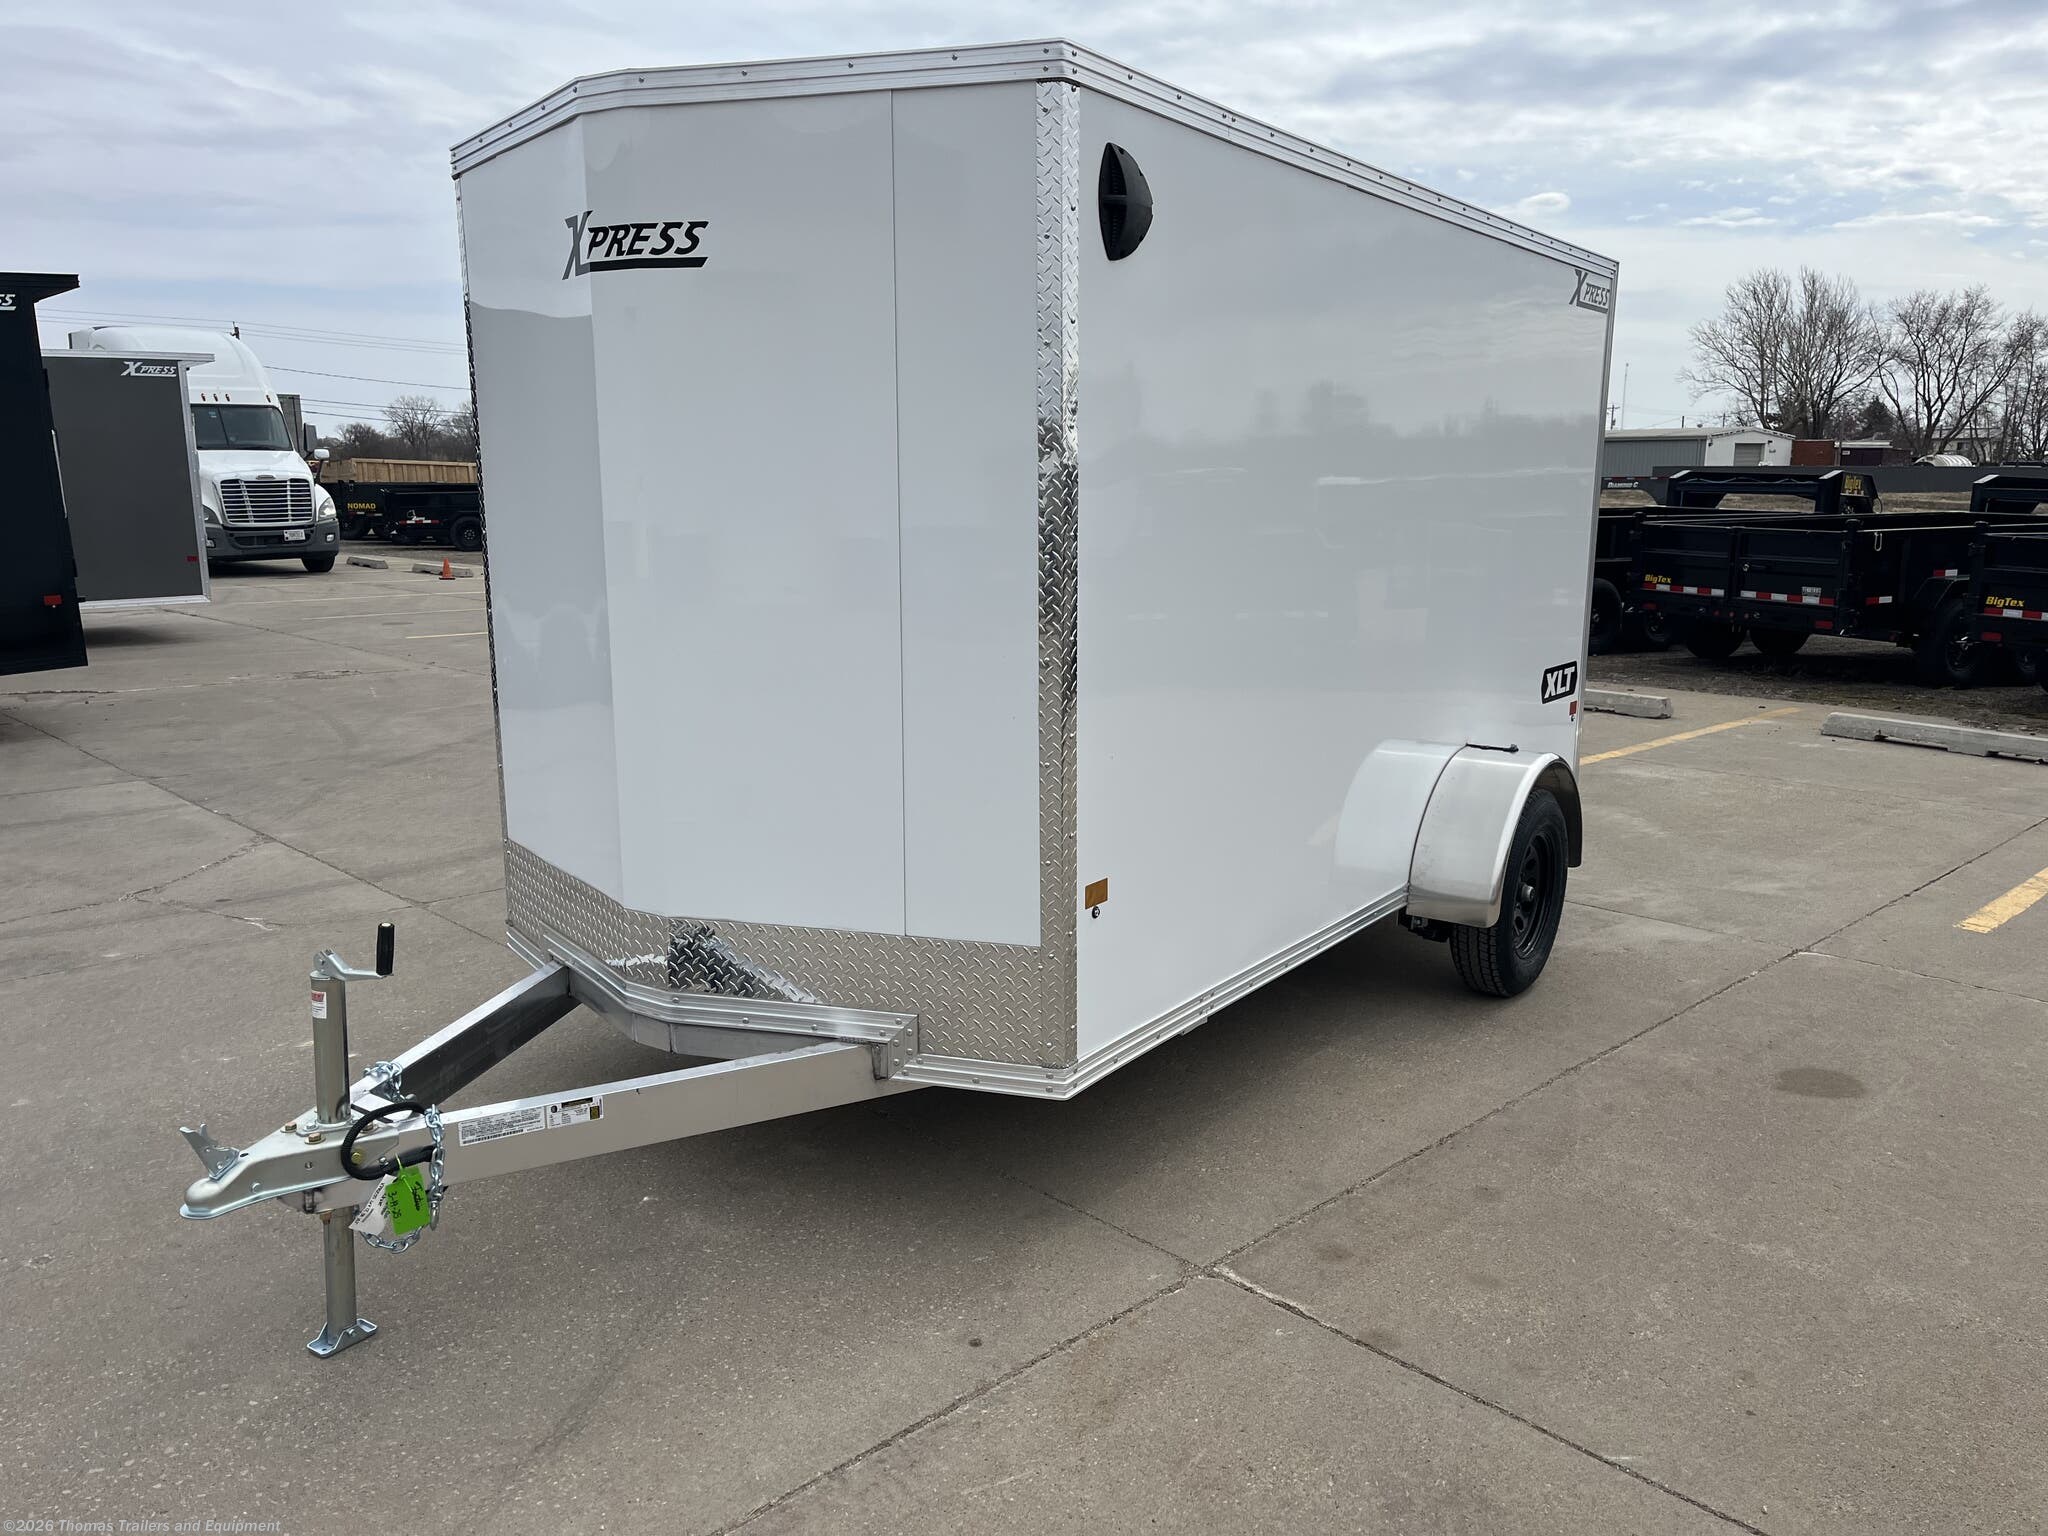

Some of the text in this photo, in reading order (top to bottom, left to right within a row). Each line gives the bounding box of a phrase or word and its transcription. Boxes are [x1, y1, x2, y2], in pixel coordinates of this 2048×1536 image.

[562, 210, 709, 280] XPRESS
[1569, 269, 1610, 312] XPRESS
[120, 361, 177, 377] XPRESS
[1985, 596, 2025, 608] BigTex
[1544, 666, 1576, 699] XLT
